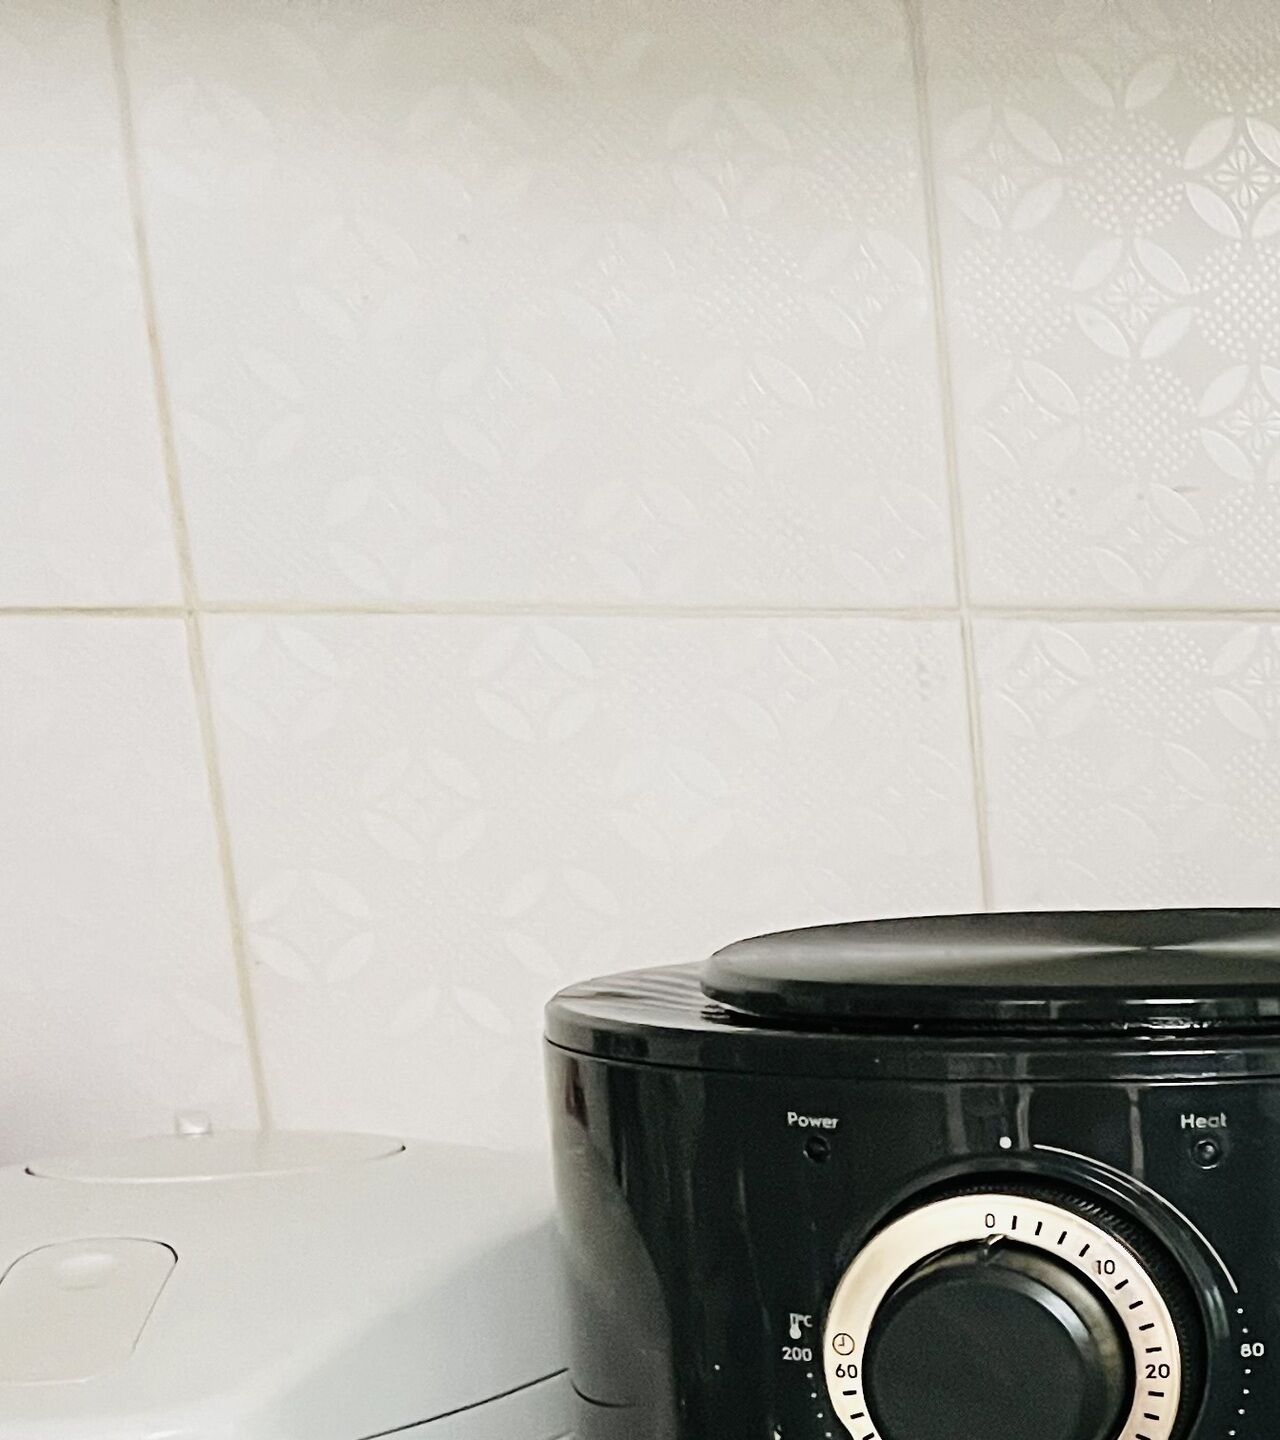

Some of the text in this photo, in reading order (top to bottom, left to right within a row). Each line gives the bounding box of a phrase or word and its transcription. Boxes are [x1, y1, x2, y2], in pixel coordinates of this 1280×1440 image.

[787, 1111, 839, 1129] Power
[1180, 1113, 1227, 1129] Heat
[984, 1213, 996, 1229] 0
[1096, 1260, 1116, 1276] 10
[782, 1347, 813, 1362] 200
[1240, 1342, 1265, 1357] 80
[835, 1363, 858, 1378] 60
[1145, 1363, 1170, 1379] 20
